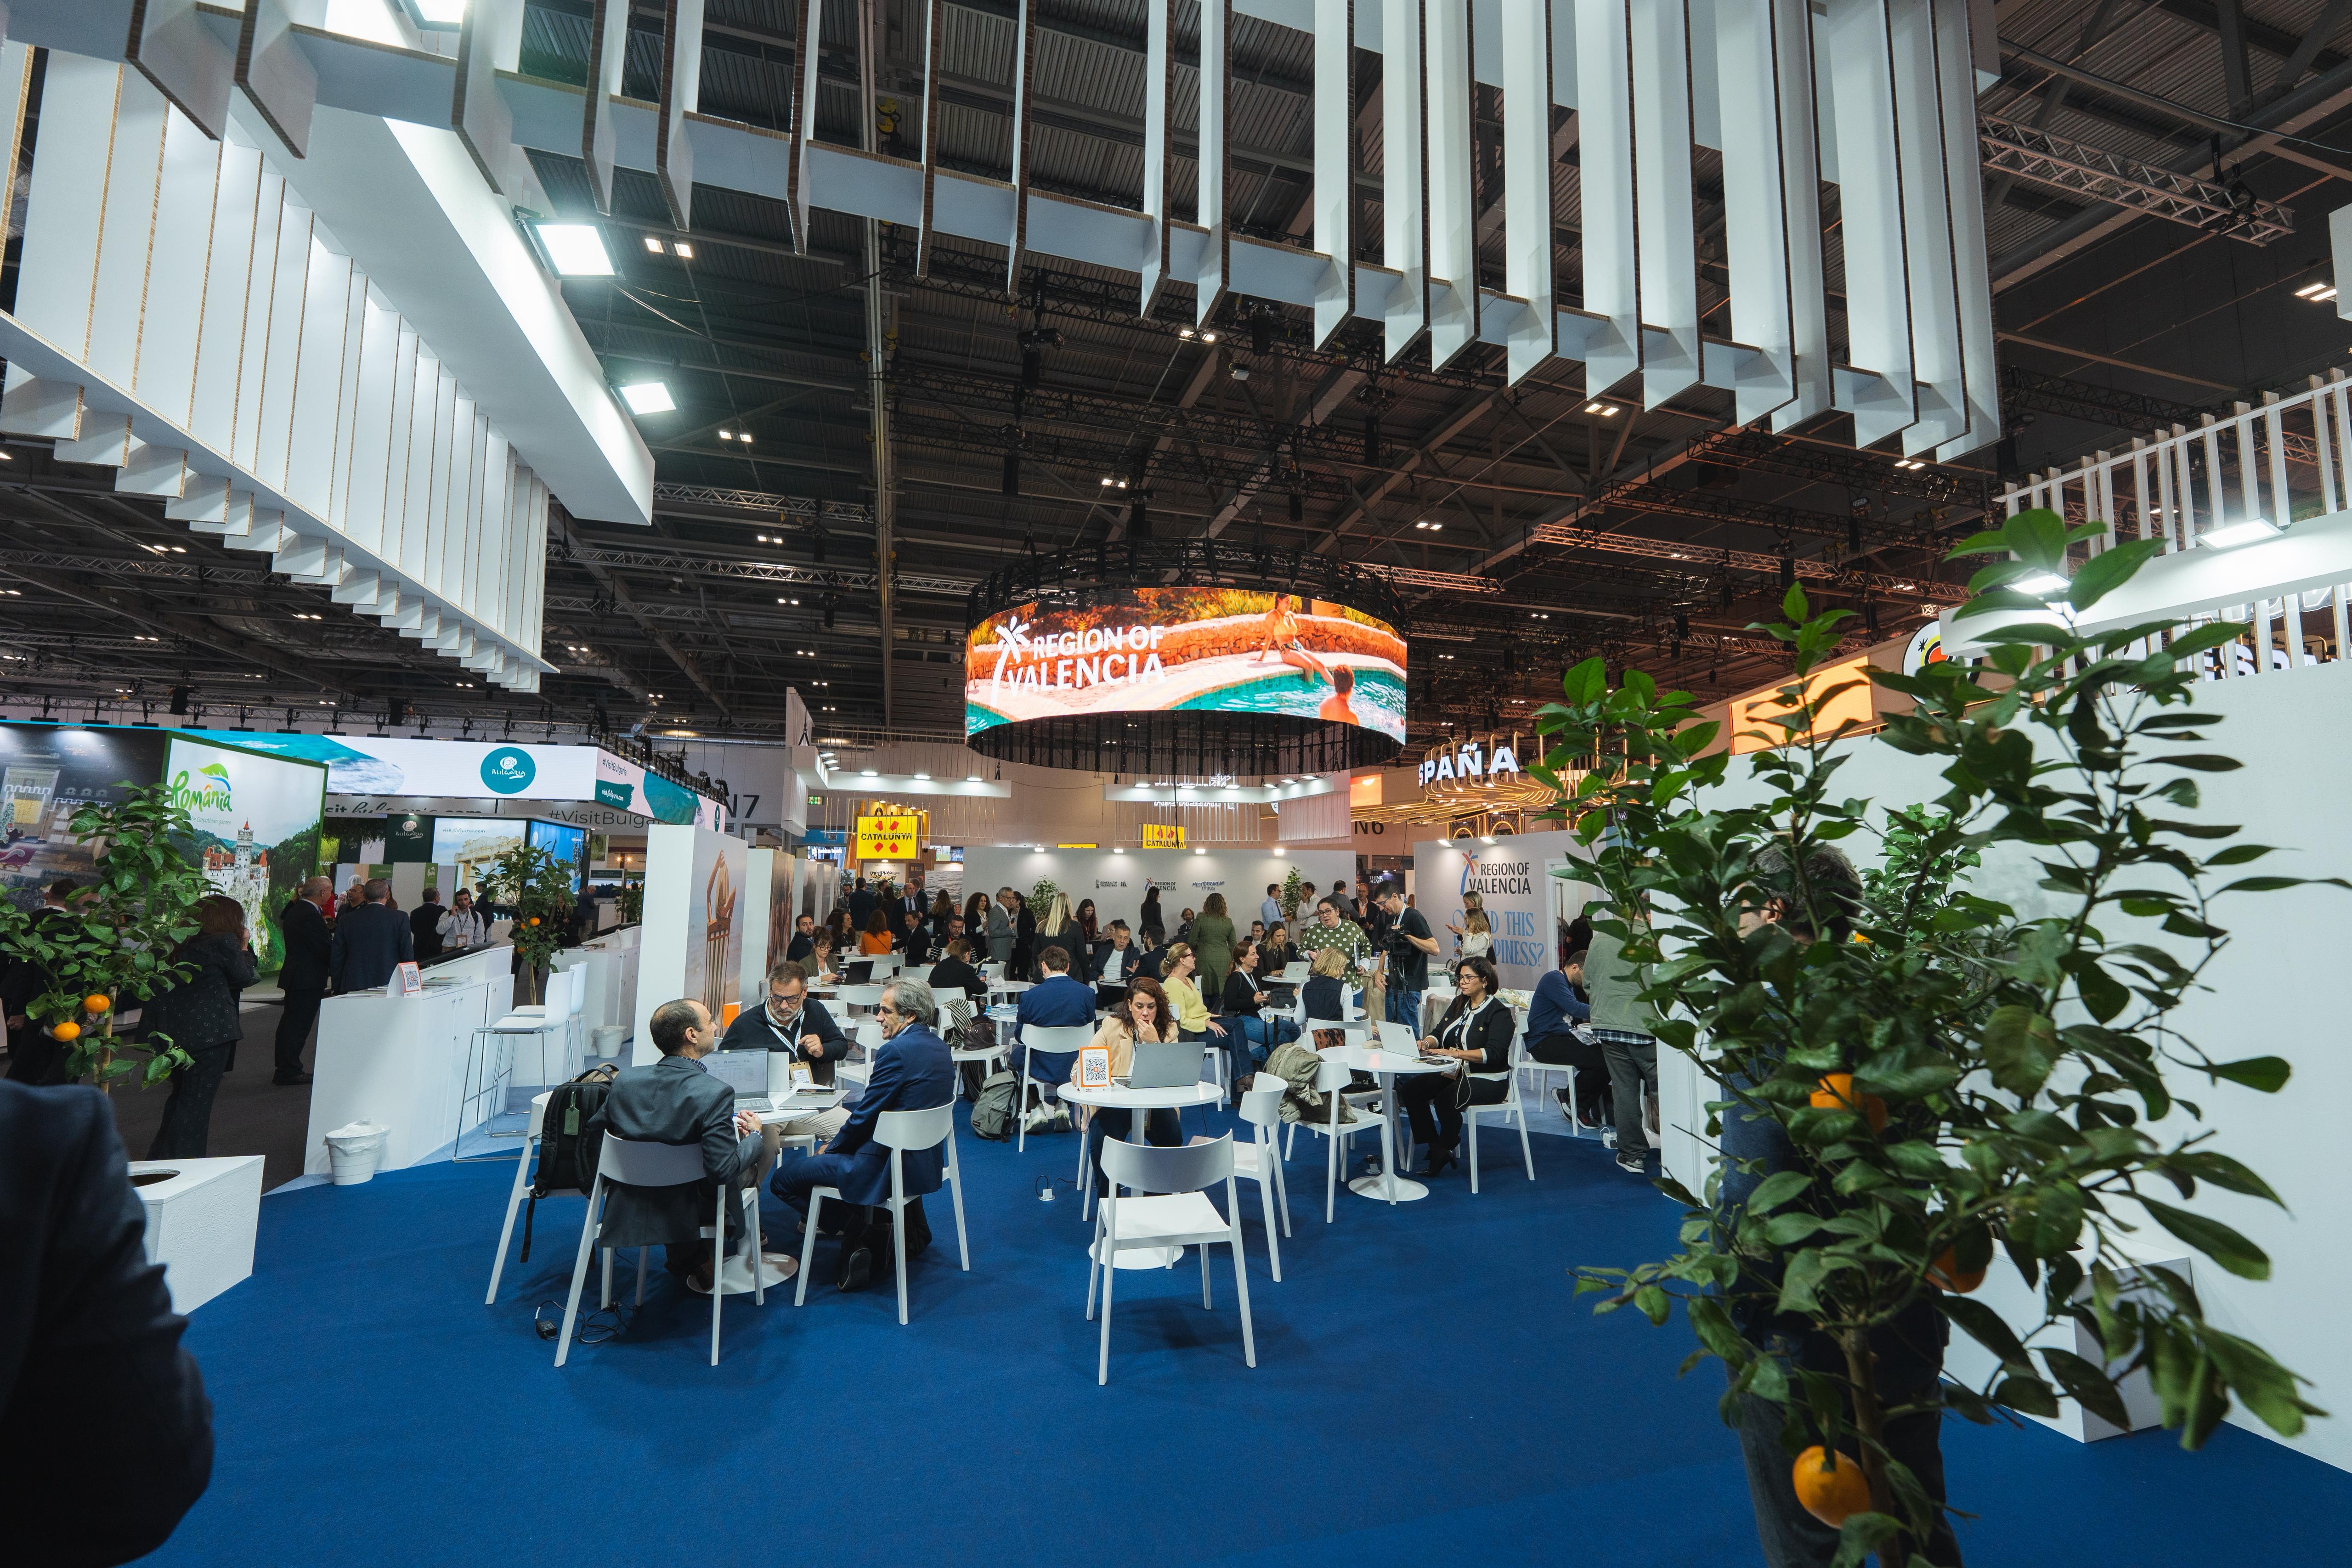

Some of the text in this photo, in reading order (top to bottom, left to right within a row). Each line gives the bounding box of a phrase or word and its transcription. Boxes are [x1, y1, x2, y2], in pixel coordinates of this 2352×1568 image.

[1034, 625, 1165, 660] REGION OF
[1007, 653, 1167, 697] VALENCIA
[492, 768, 526, 779] BULGARIA
[602, 758, 627, 776] #VisitBulgaria
[170, 771, 232, 812] România
[1355, 820, 1384, 835] N6
[861, 833, 912, 841] CATALUNYA
[1481, 862, 1530, 876] REGION OF
[1469, 877, 1532, 894] VALENCIA
[1504, 911, 1535, 937] THIS
[1493, 939, 1544, 967] PINESS?
